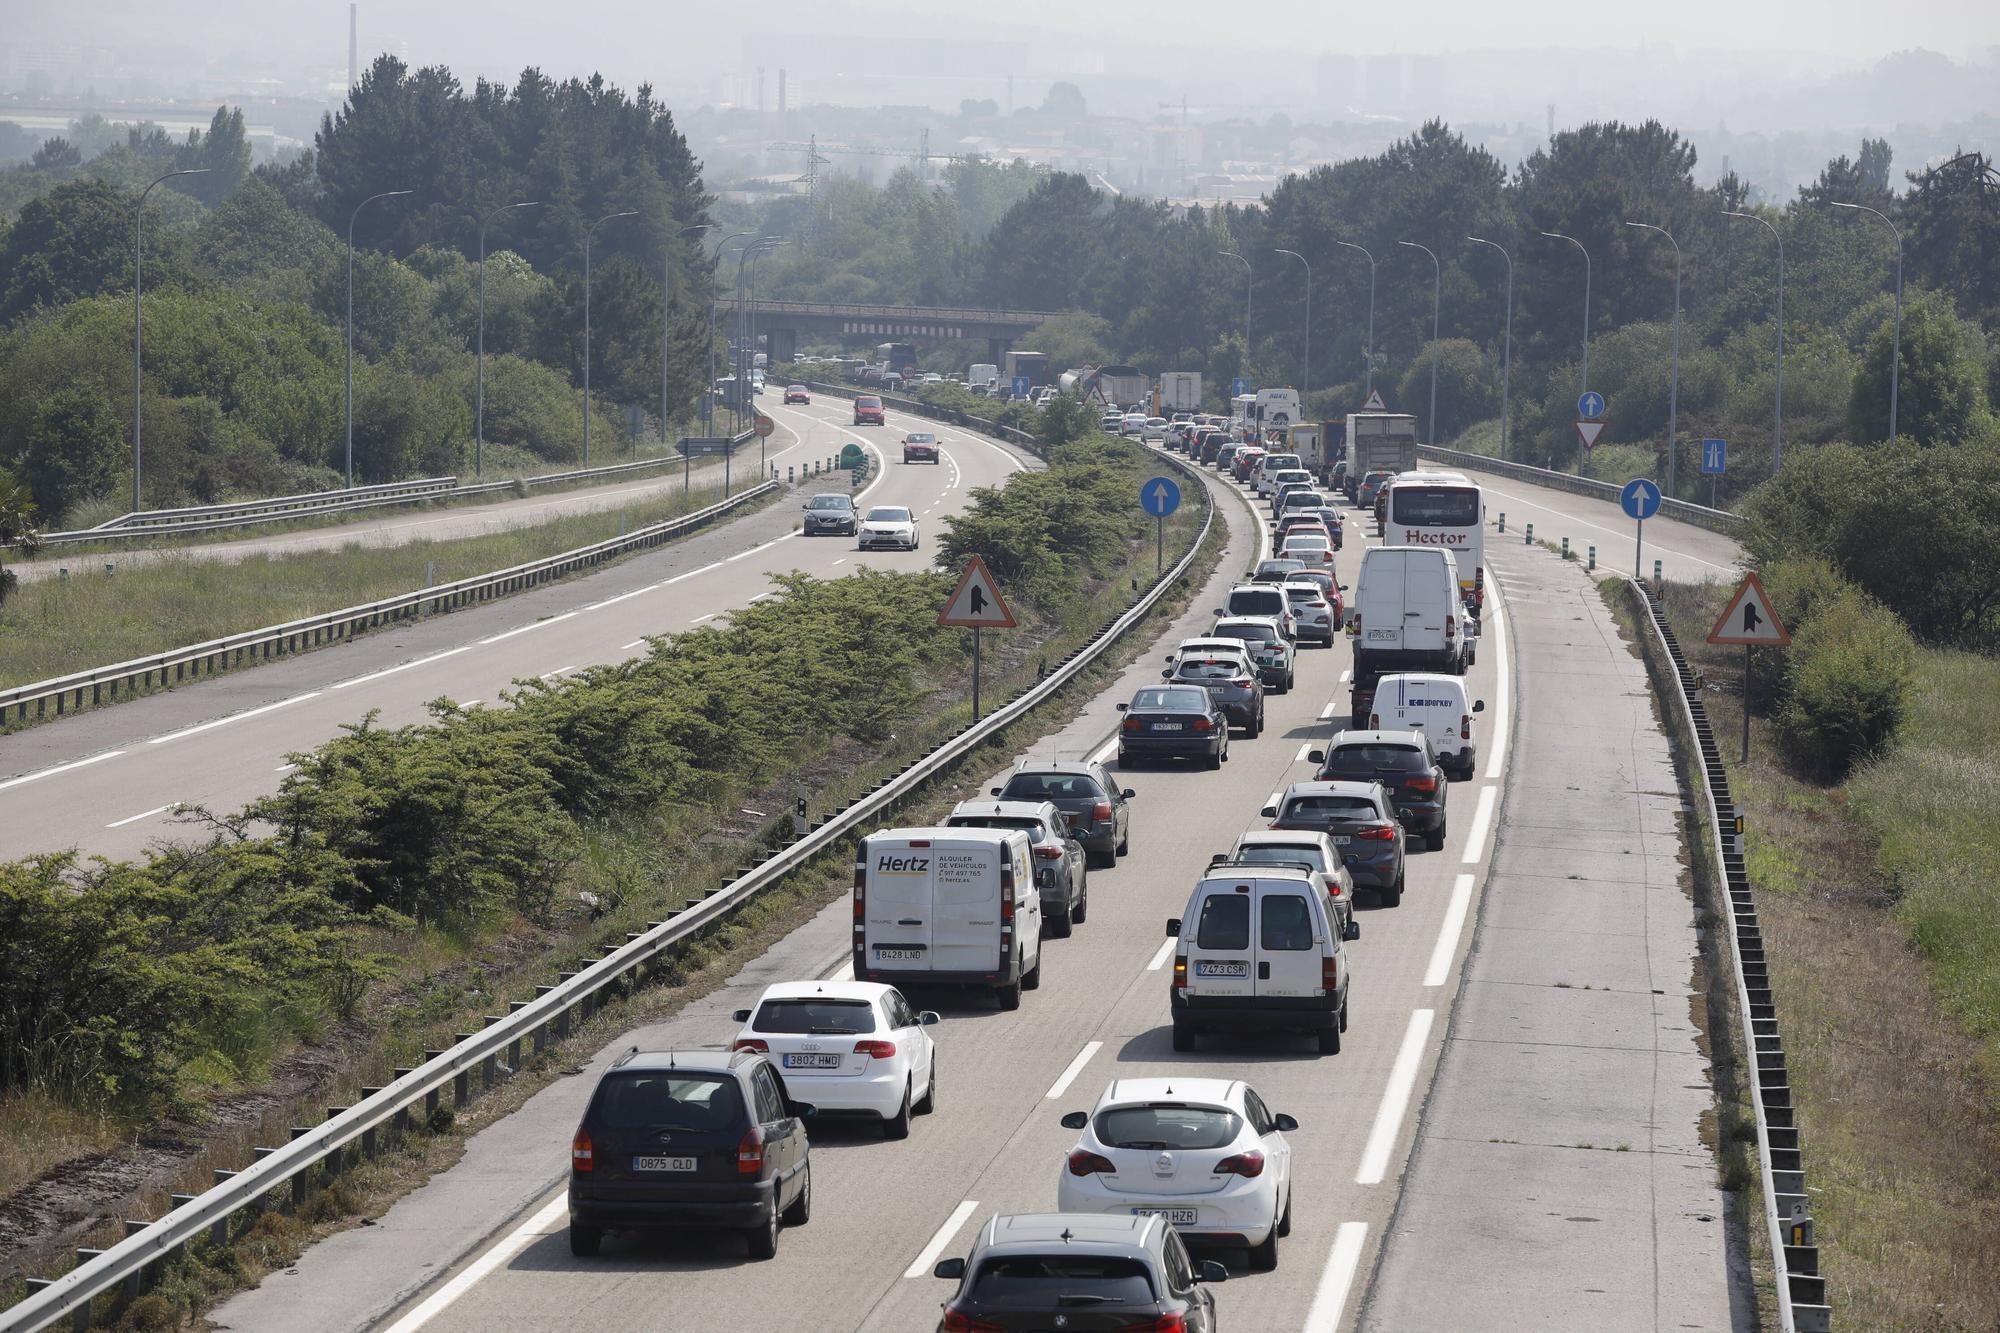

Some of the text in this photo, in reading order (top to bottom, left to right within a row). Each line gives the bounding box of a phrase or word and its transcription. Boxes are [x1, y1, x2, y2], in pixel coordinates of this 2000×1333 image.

[1406, 530, 1467, 544] Hector
[878, 856, 929, 871] Hertz
[882, 951, 921, 959] 8428 LND
[1202, 965, 1244, 974] 7473 CSR
[791, 1056, 838, 1065] 3802 HMD
[641, 1158, 692, 1169] 0875 CLD
[1794, 1205, 1803, 1214] 2
[1172, 1211, 1193, 1221] HZR
